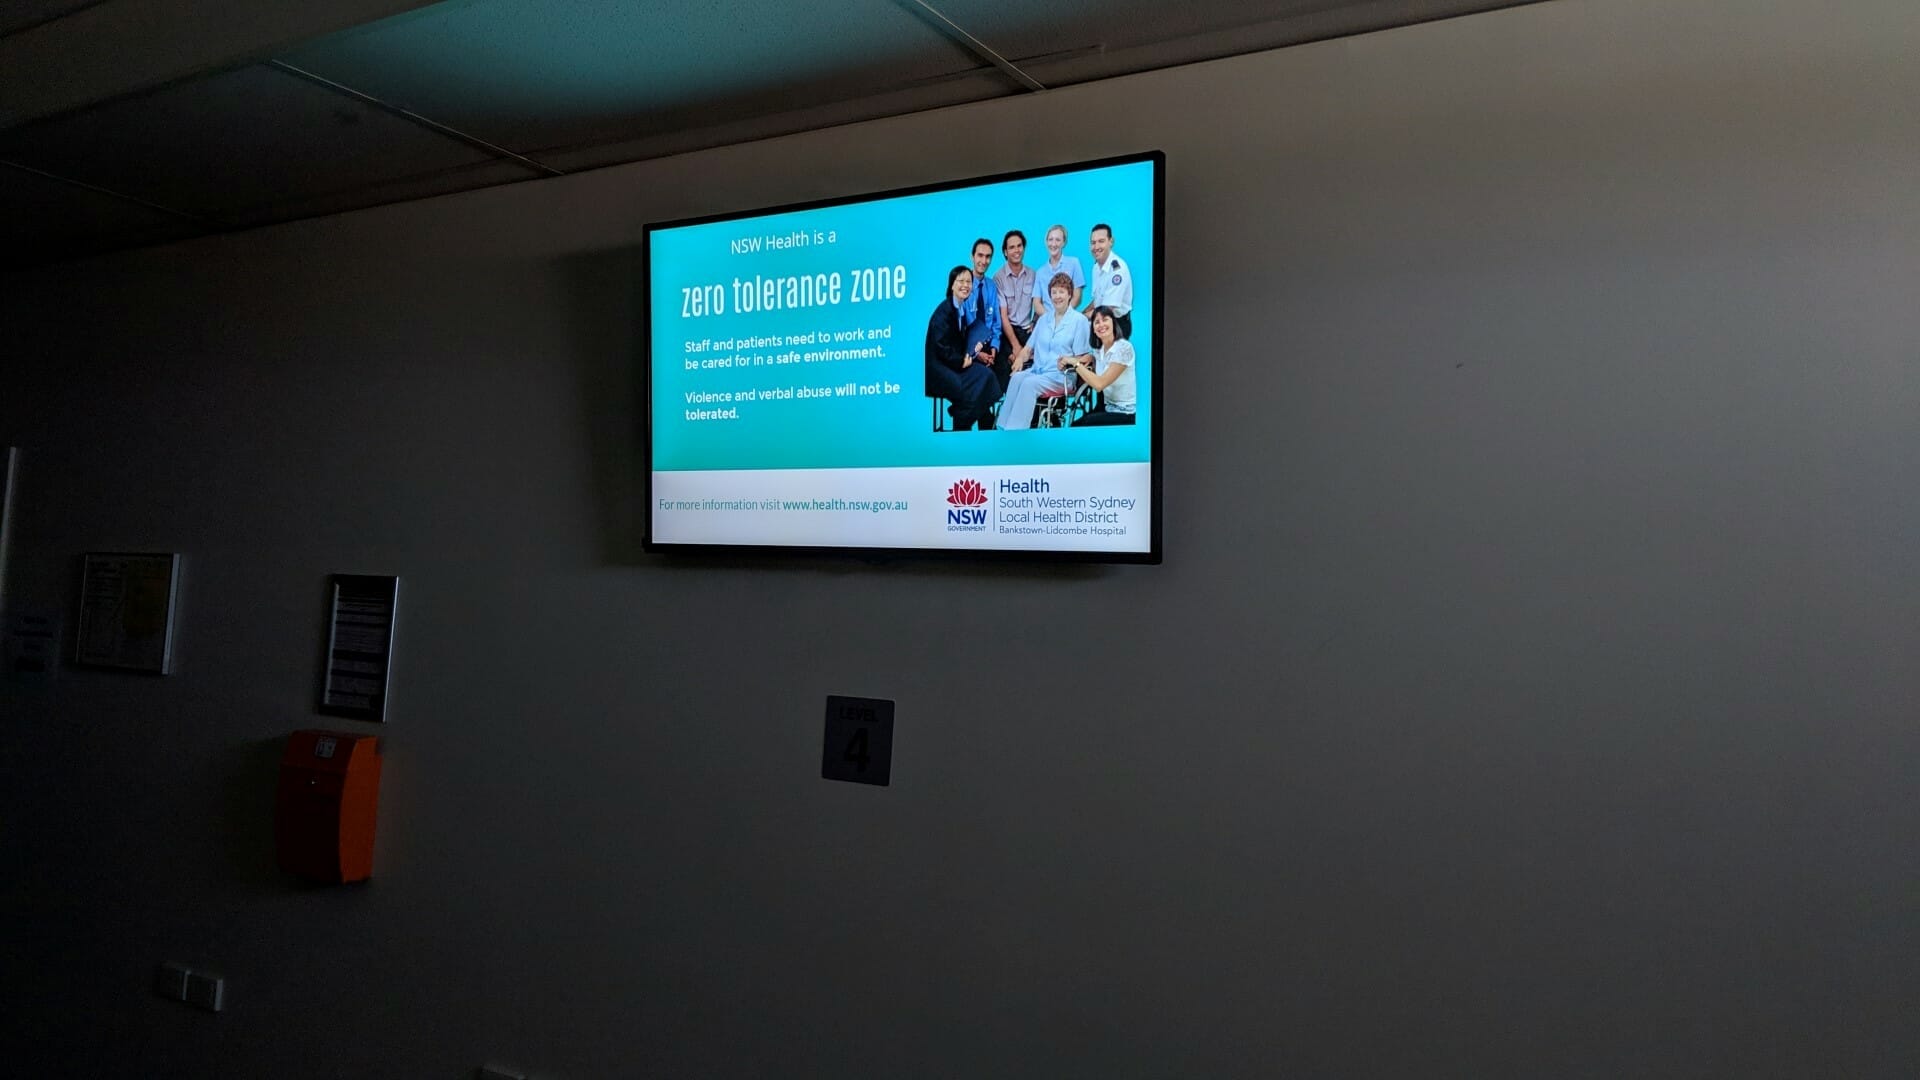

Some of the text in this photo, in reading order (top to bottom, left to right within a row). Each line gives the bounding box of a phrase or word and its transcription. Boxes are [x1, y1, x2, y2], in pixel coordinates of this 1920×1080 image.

[731, 230, 836, 254] NSW Health is a
[682, 264, 906, 318] zero tolerance zone
[685, 326, 891, 353] Staff and patients need to work and
[685, 345, 886, 370] be cared for in a safe environment.
[686, 381, 900, 404] Violence and verbal abuse will not be
[686, 407, 740, 421] tolerated.
[1000, 478, 1050, 493] Health
[659, 497, 908, 513] For more information visit www.health.nsw.gov.au
[999, 496, 1136, 512] South Western Sydney
[948, 509, 987, 525] NSW
[999, 511, 1118, 524] Local Health District
[999, 525, 1126, 537] Bankstown-Lidcombe Hospital
[840, 707, 879, 721] LEVEL
[845, 728, 870, 772] 4
